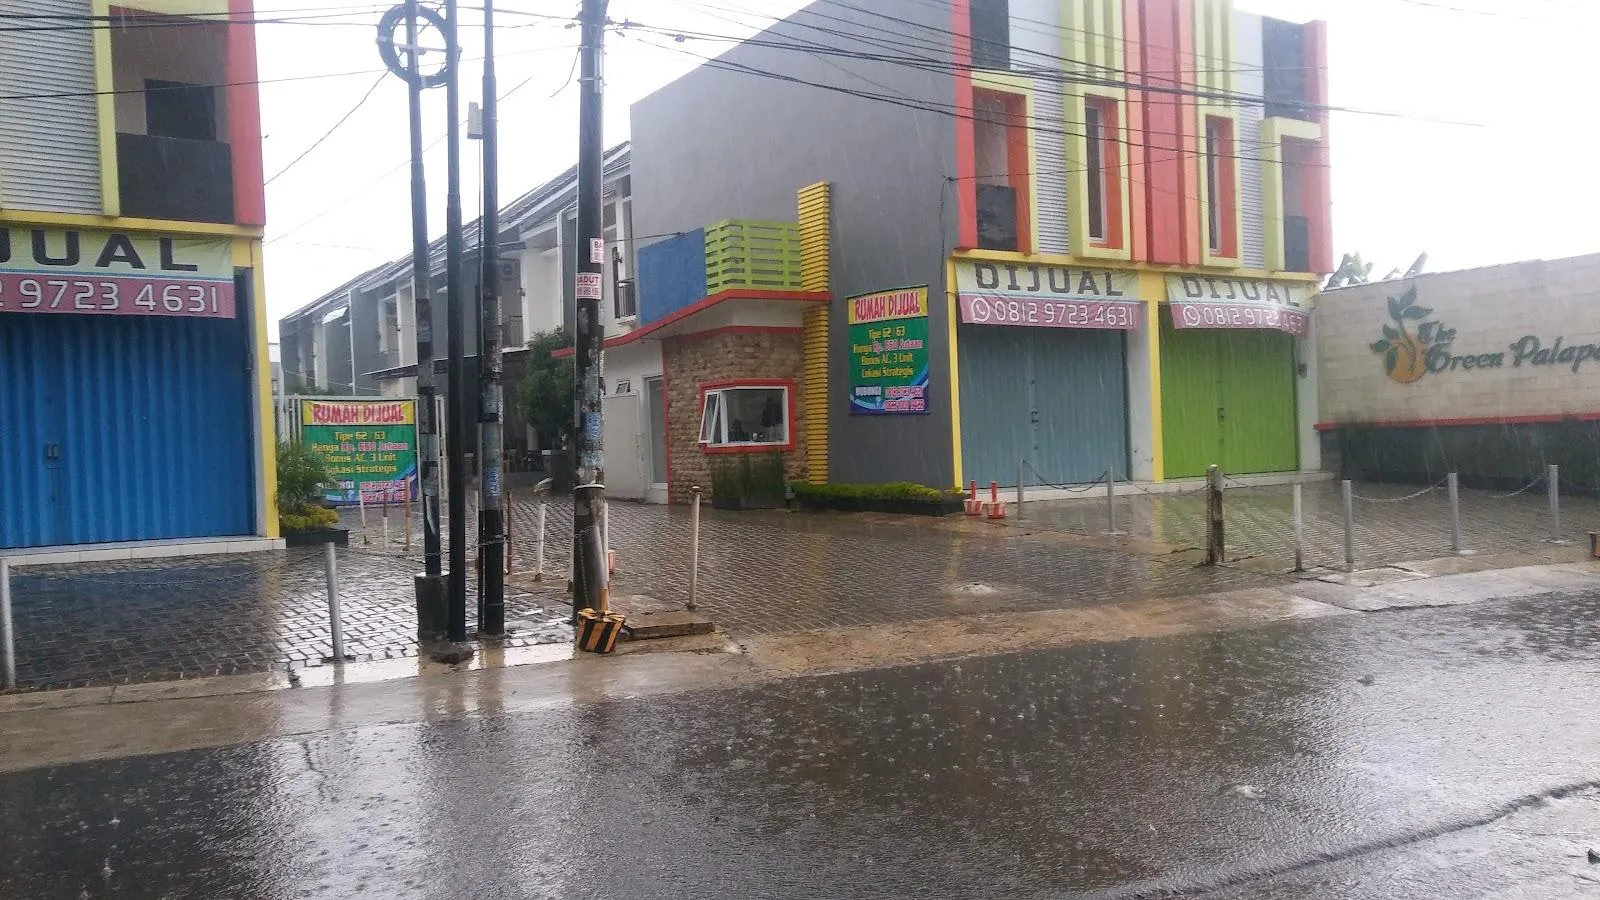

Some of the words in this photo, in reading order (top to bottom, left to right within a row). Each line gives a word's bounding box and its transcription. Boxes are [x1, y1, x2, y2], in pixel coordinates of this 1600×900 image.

[975, 263, 1123, 296] DIJUAL
[1181, 275, 1300, 308] DIJUAL
[19, 278, 119, 311] 9723
[135, 283, 219, 314] 4631
[854, 295, 886, 321] RUMAH
[888, 291, 921, 317] DIJUAL
[994, 300, 1039, 324] 0812
[1044, 303, 1089, 325] 9723
[1095, 305, 1133, 327] 4631
[1203, 306, 1242, 326] 0812
[1418, 320, 1457, 344] The
[1424, 342, 1504, 373] Green
[313, 404, 359, 423] RUMAH
[363, 404, 405, 423] DIJUAL
